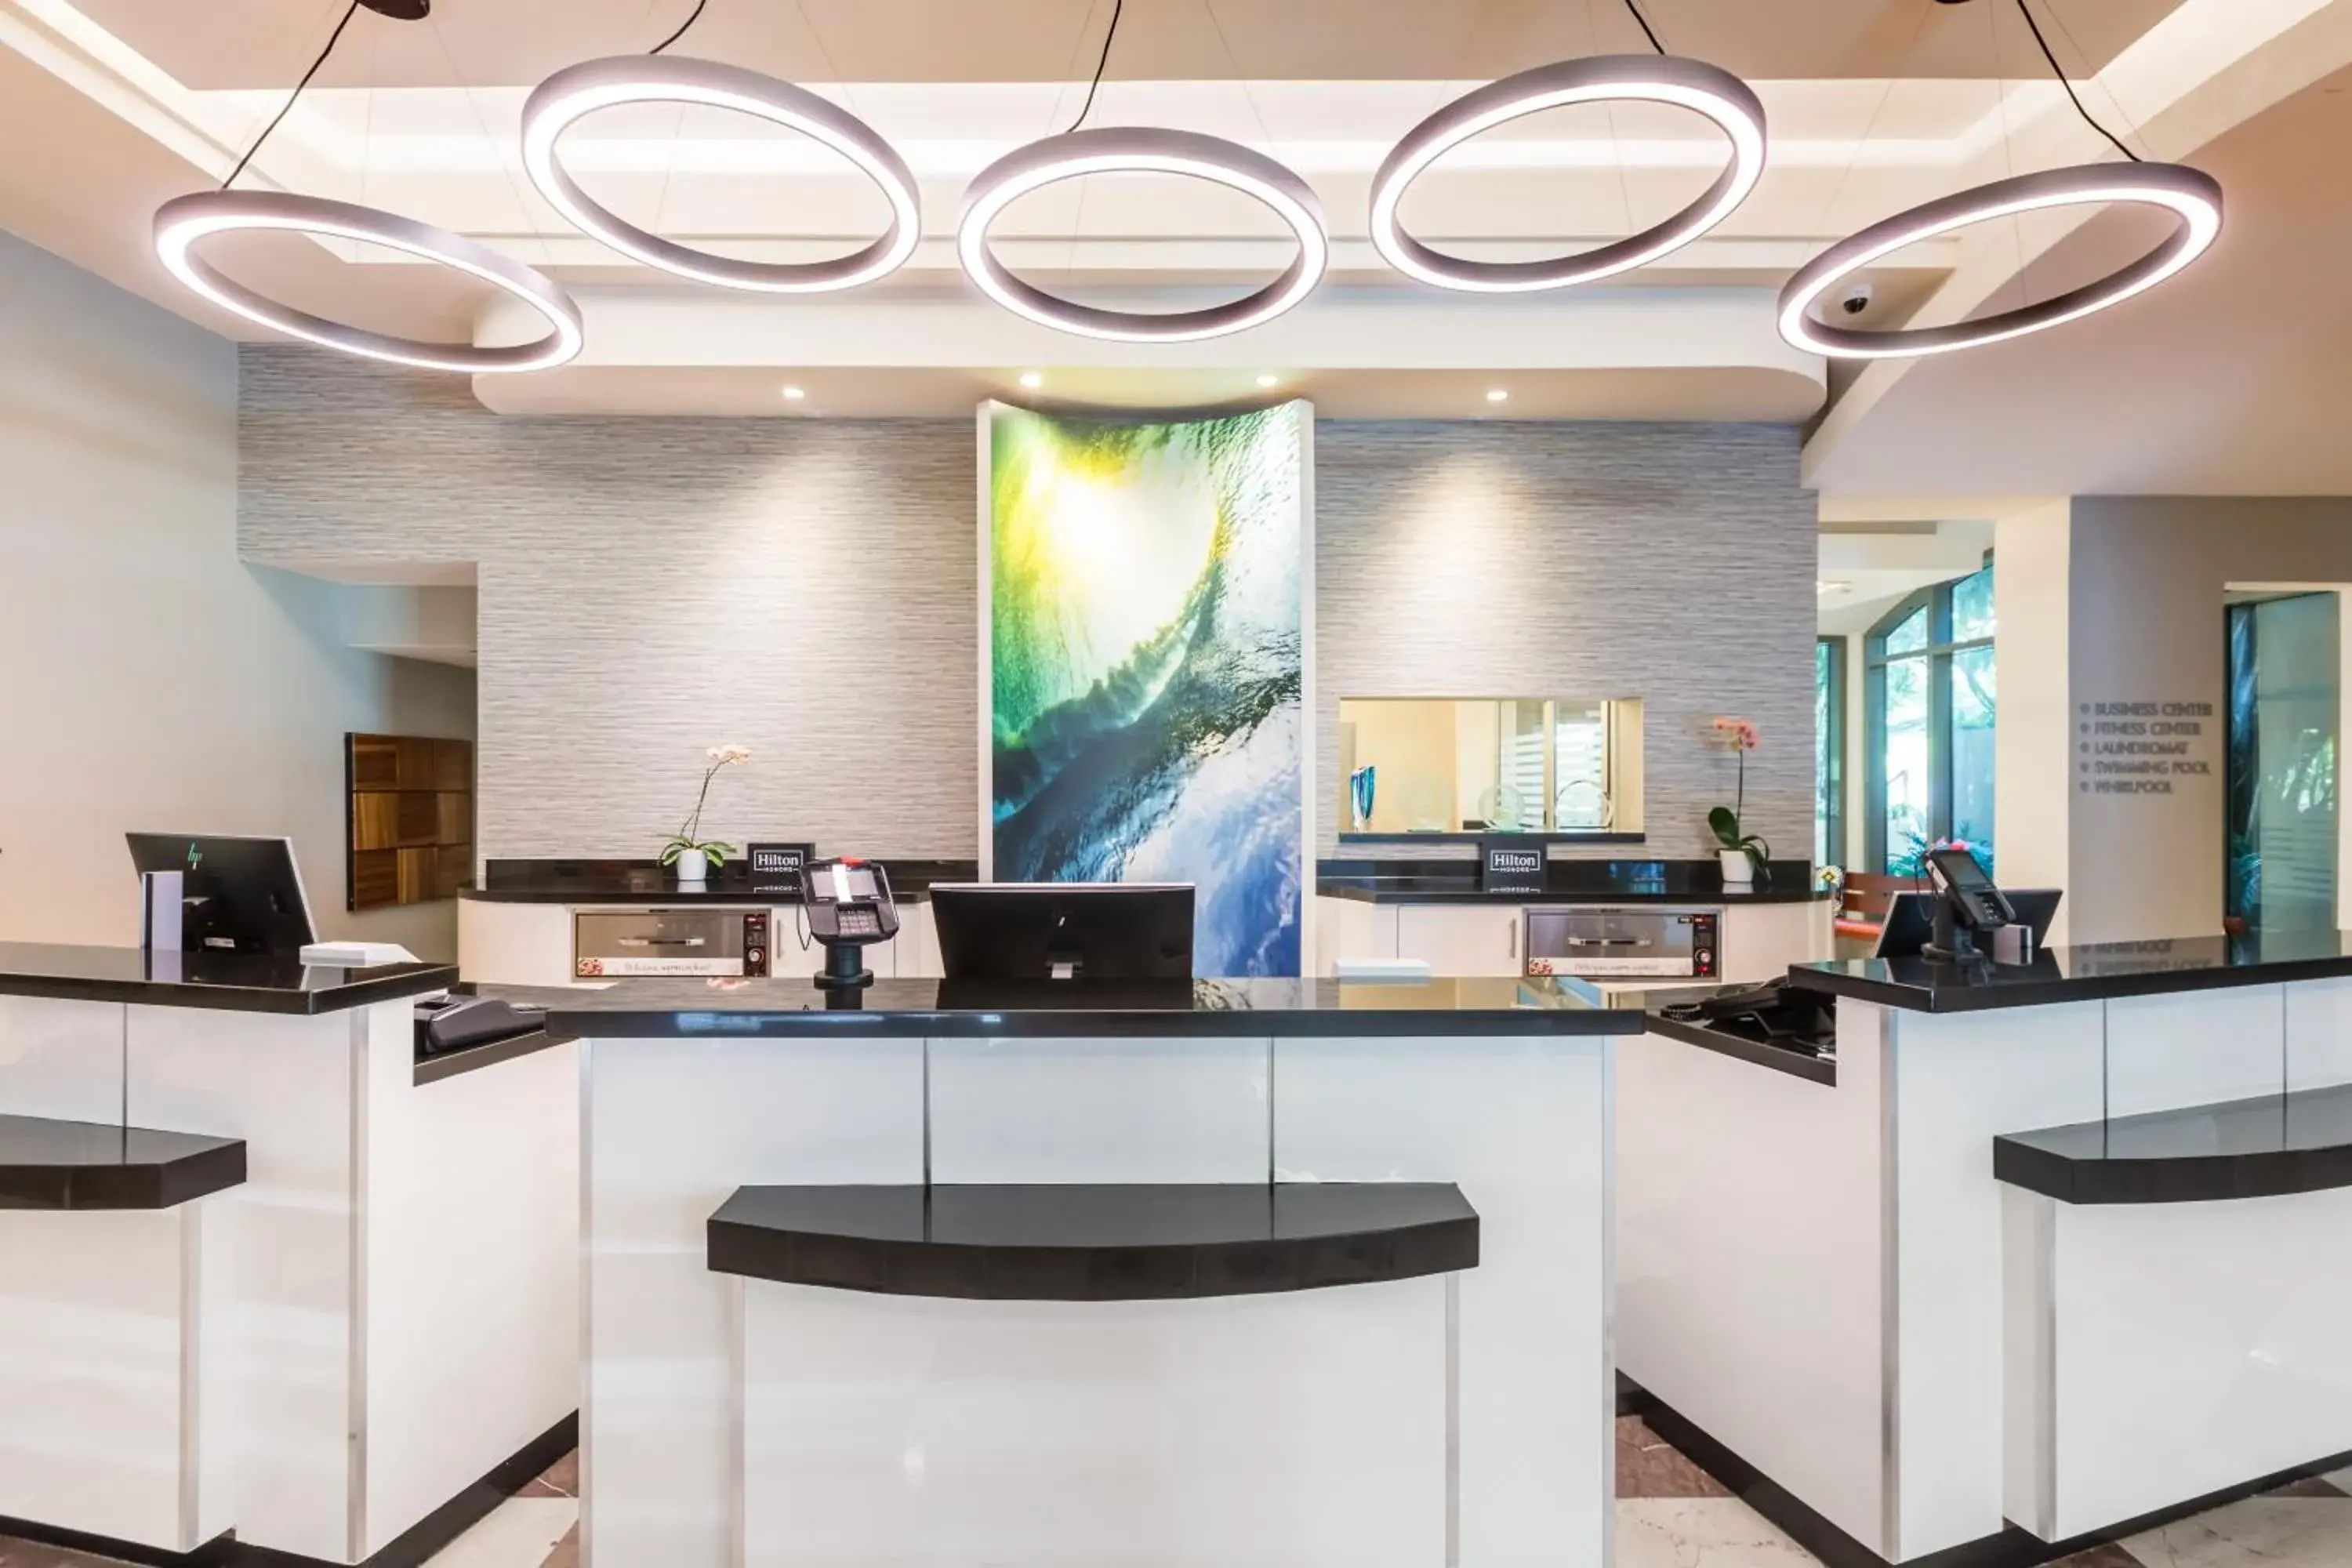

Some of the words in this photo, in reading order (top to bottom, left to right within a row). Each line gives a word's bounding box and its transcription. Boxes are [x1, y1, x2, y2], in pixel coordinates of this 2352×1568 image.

[2095, 702, 2158, 717] BUSINESS
[2162, 702, 2212, 717] CENTER
[2094, 722, 2147, 735] FITNESS
[2150, 722, 2201, 735] CENTER
[2094, 741, 2189, 754] LAUNDROMAT
[2094, 760, 2169, 774] SWIMMING
[2171, 760, 2211, 775] POOL
[758, 854, 799, 866] Hilton
[1494, 854, 1536, 866] Hilton
